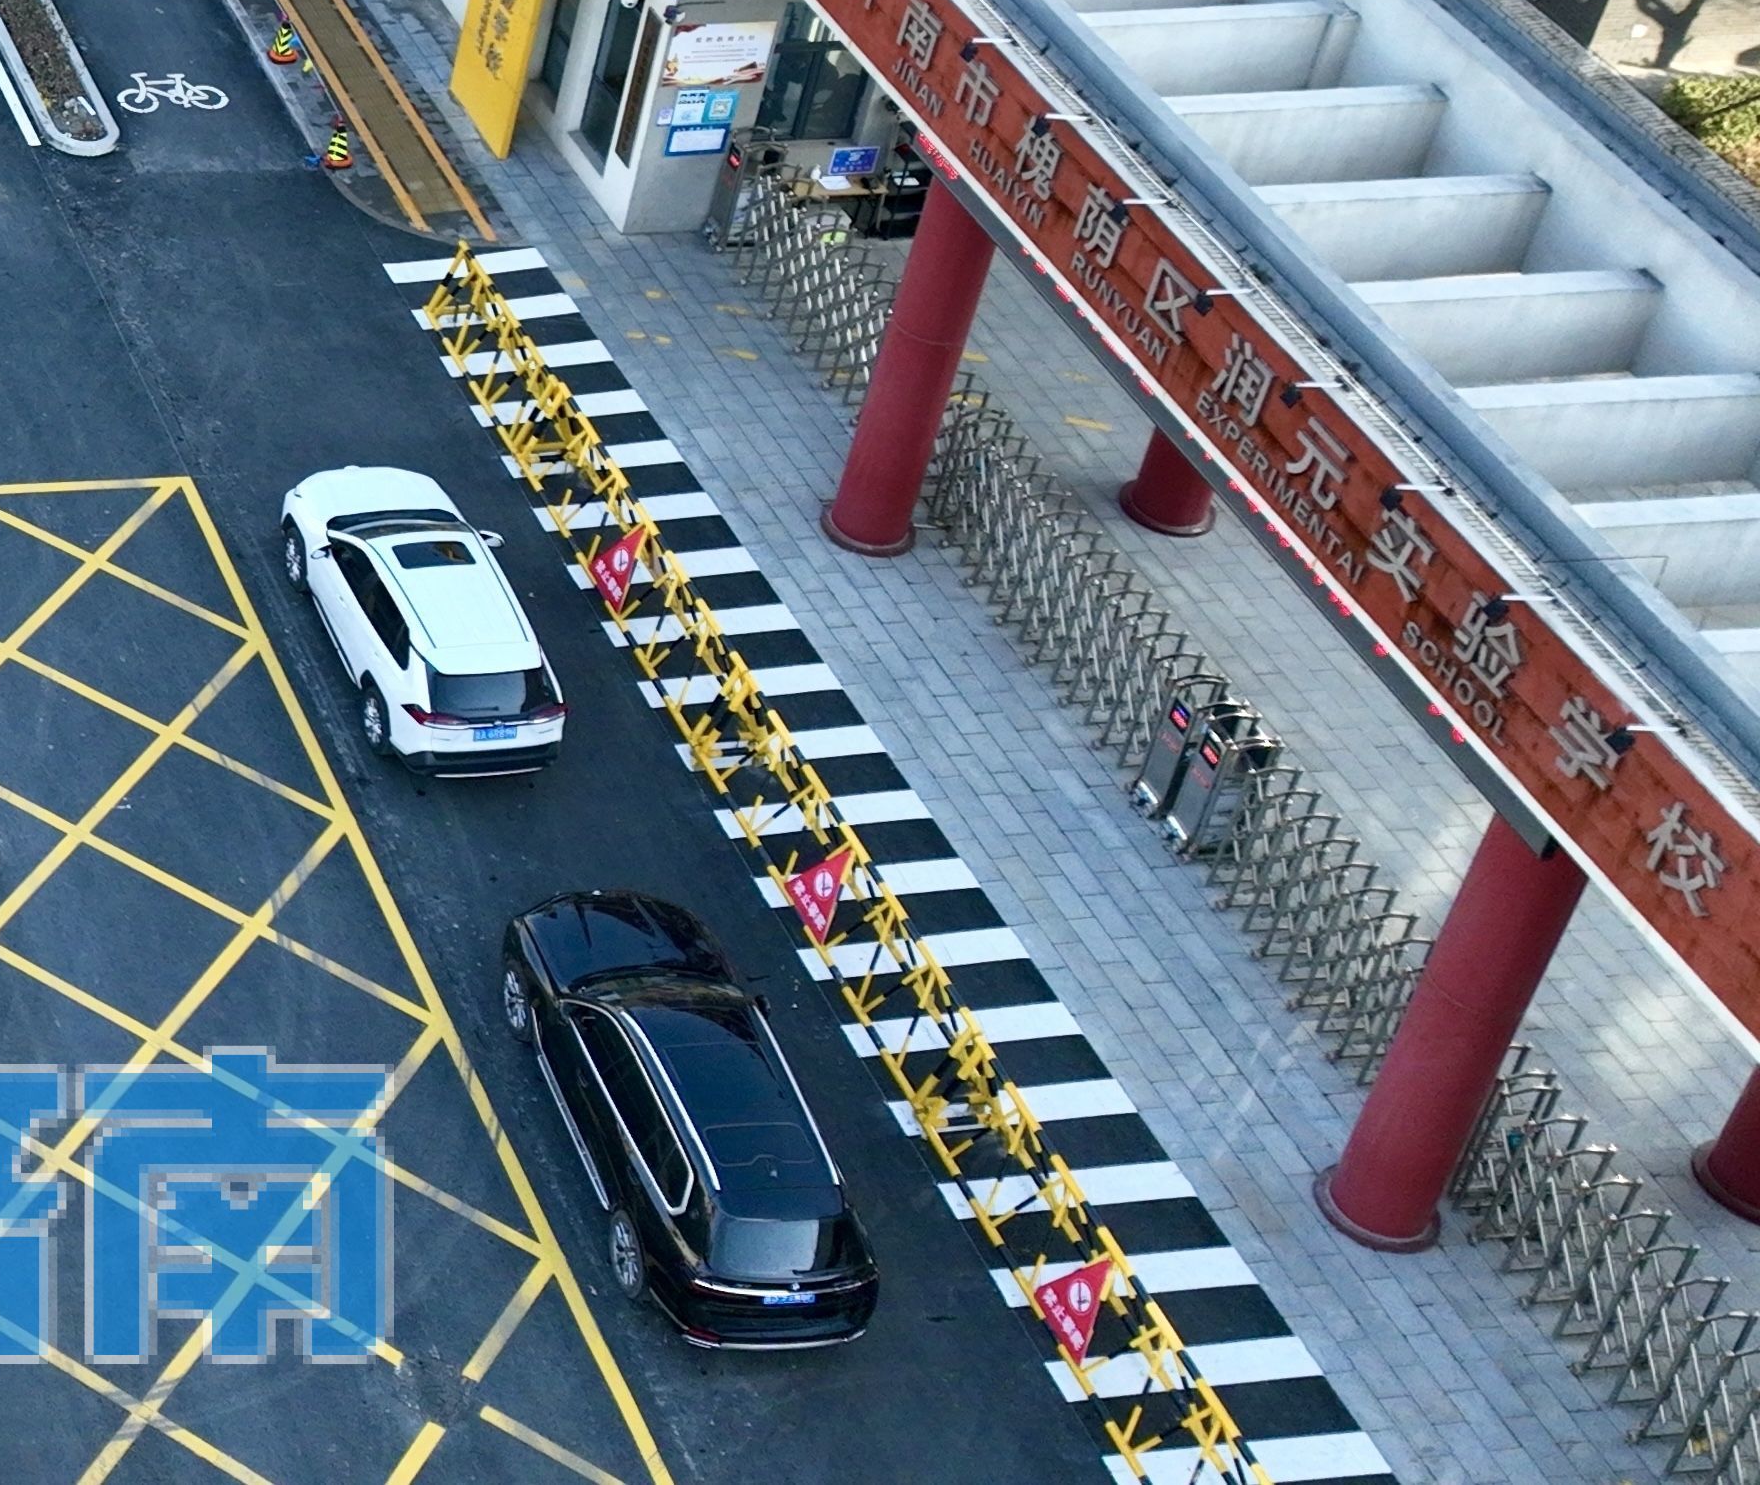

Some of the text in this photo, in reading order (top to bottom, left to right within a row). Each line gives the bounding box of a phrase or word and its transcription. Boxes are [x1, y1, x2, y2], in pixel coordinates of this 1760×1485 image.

[893, 58, 944, 120] JINAN
[967, 137, 1046, 230] HUAIYIN
[1070, 251, 1168, 366] RUNYUAN
[1402, 620, 1507, 746] SCHOOL
